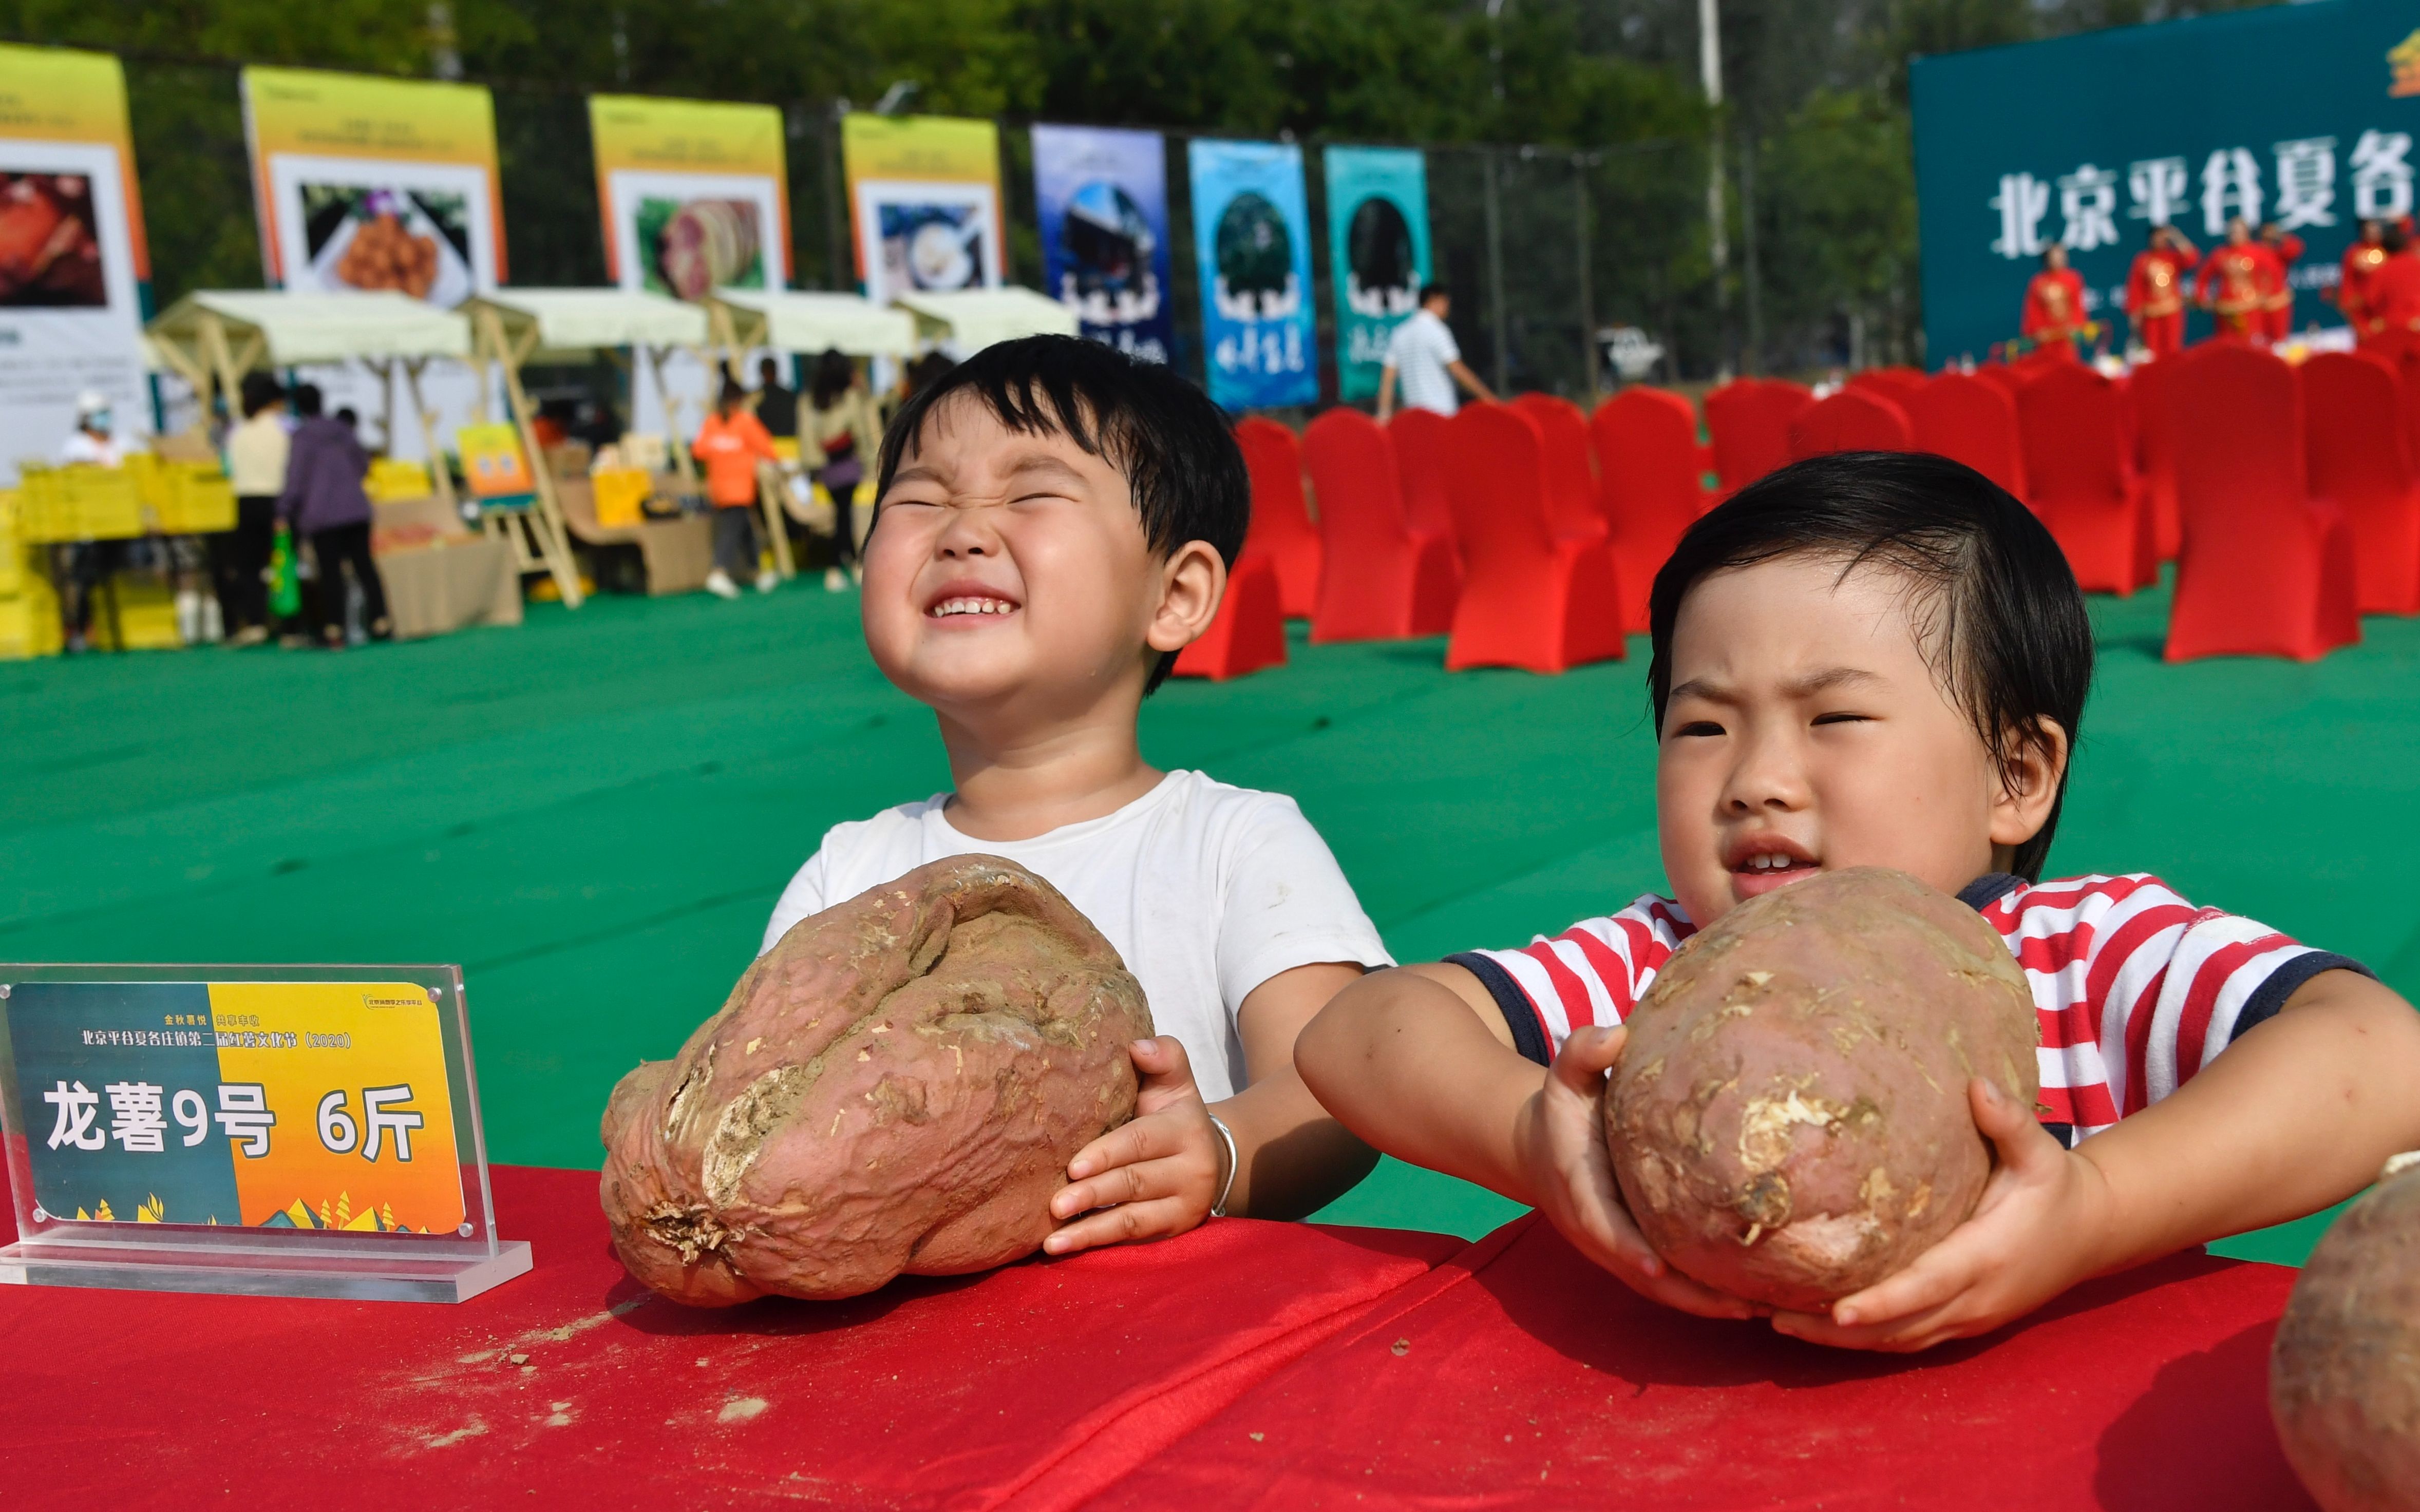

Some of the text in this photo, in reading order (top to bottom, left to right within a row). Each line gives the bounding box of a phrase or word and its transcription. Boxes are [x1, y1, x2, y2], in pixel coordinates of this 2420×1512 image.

[1989, 128, 2414, 259] 北京平谷夏各
[164, 1014, 260, 1026] 金秋薯悦 共享丰收
[44, 1080, 424, 1163] 龙薯9号 6斤
